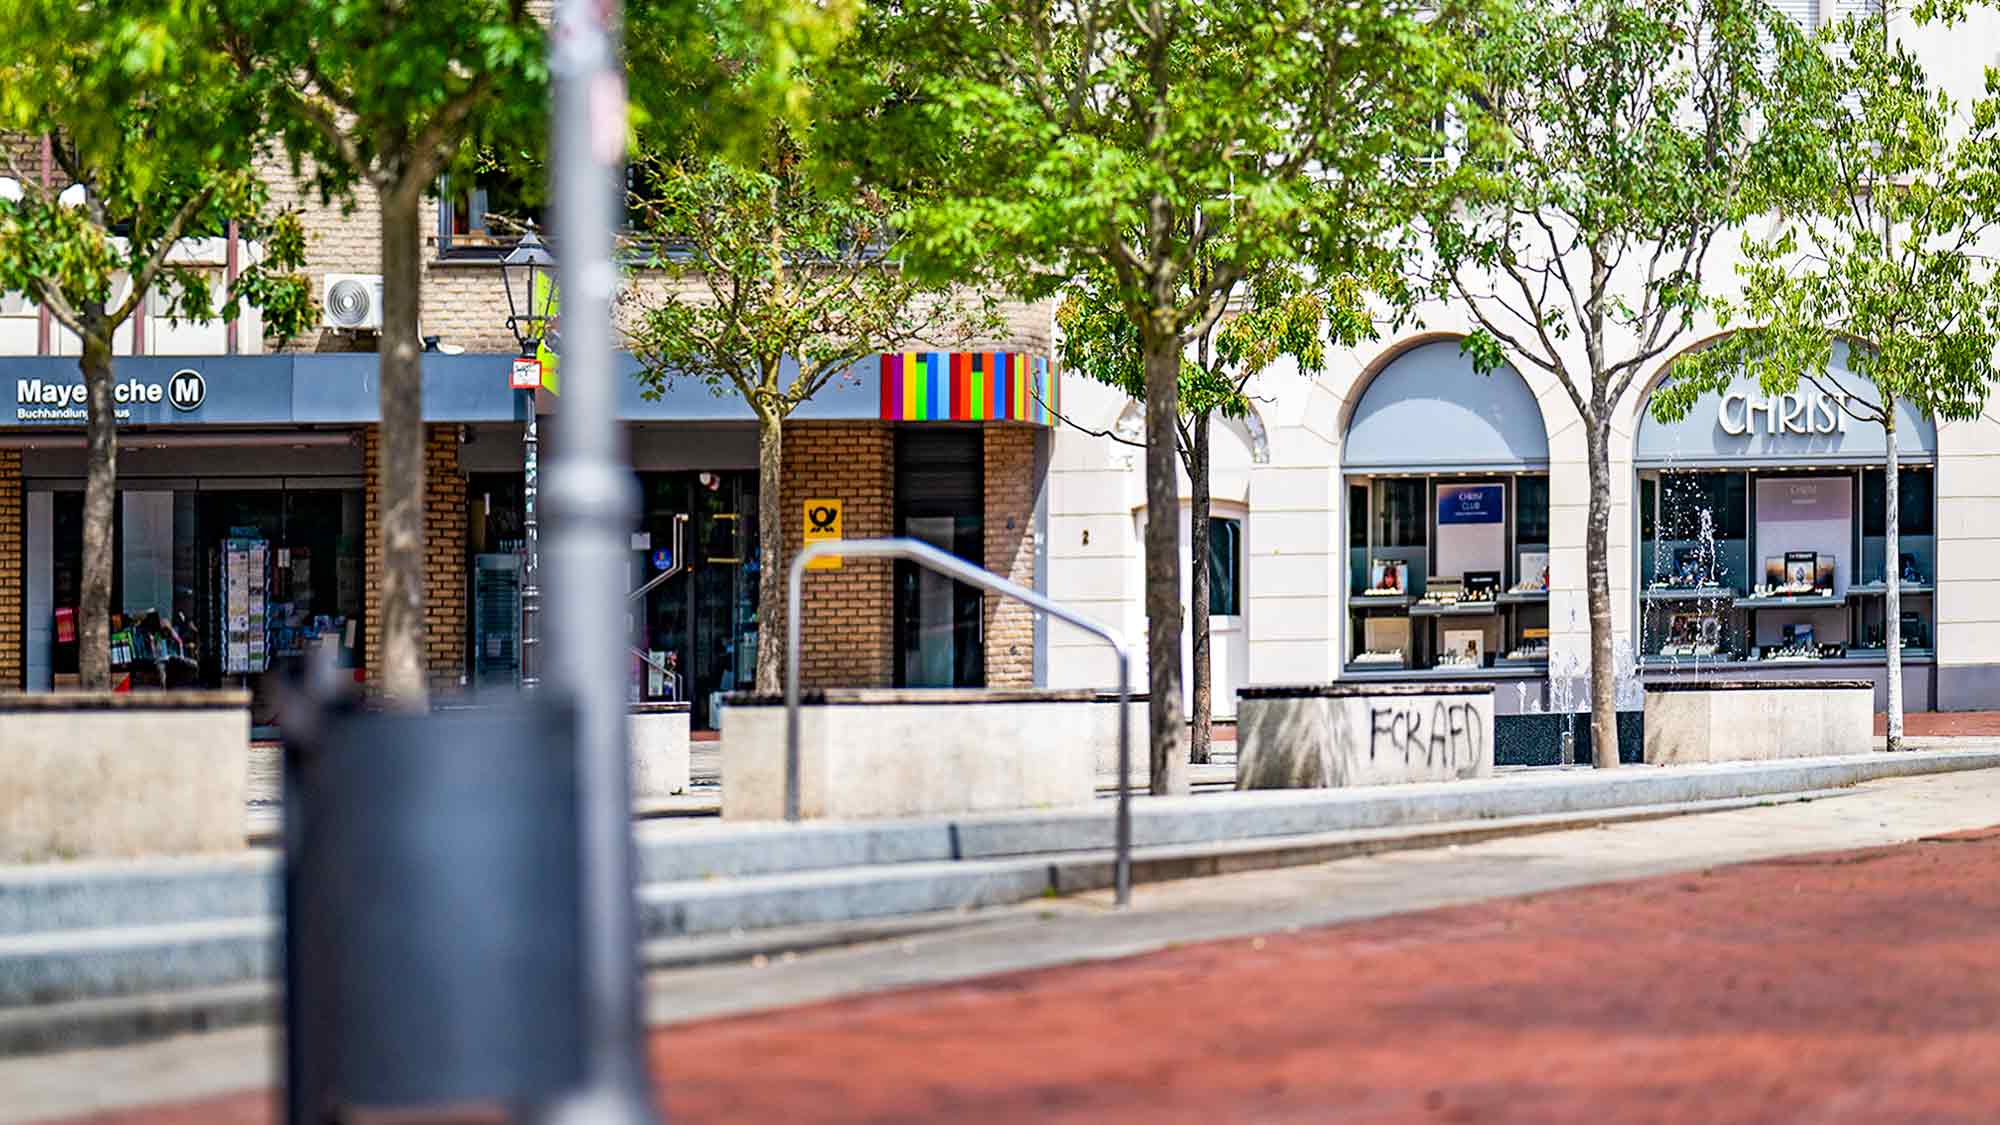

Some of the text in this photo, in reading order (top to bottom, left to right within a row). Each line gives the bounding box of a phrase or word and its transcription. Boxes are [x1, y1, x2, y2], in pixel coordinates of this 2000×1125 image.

[17, 377, 200, 408] Mayeche M
[1719, 392, 1853, 435] CHRIST
